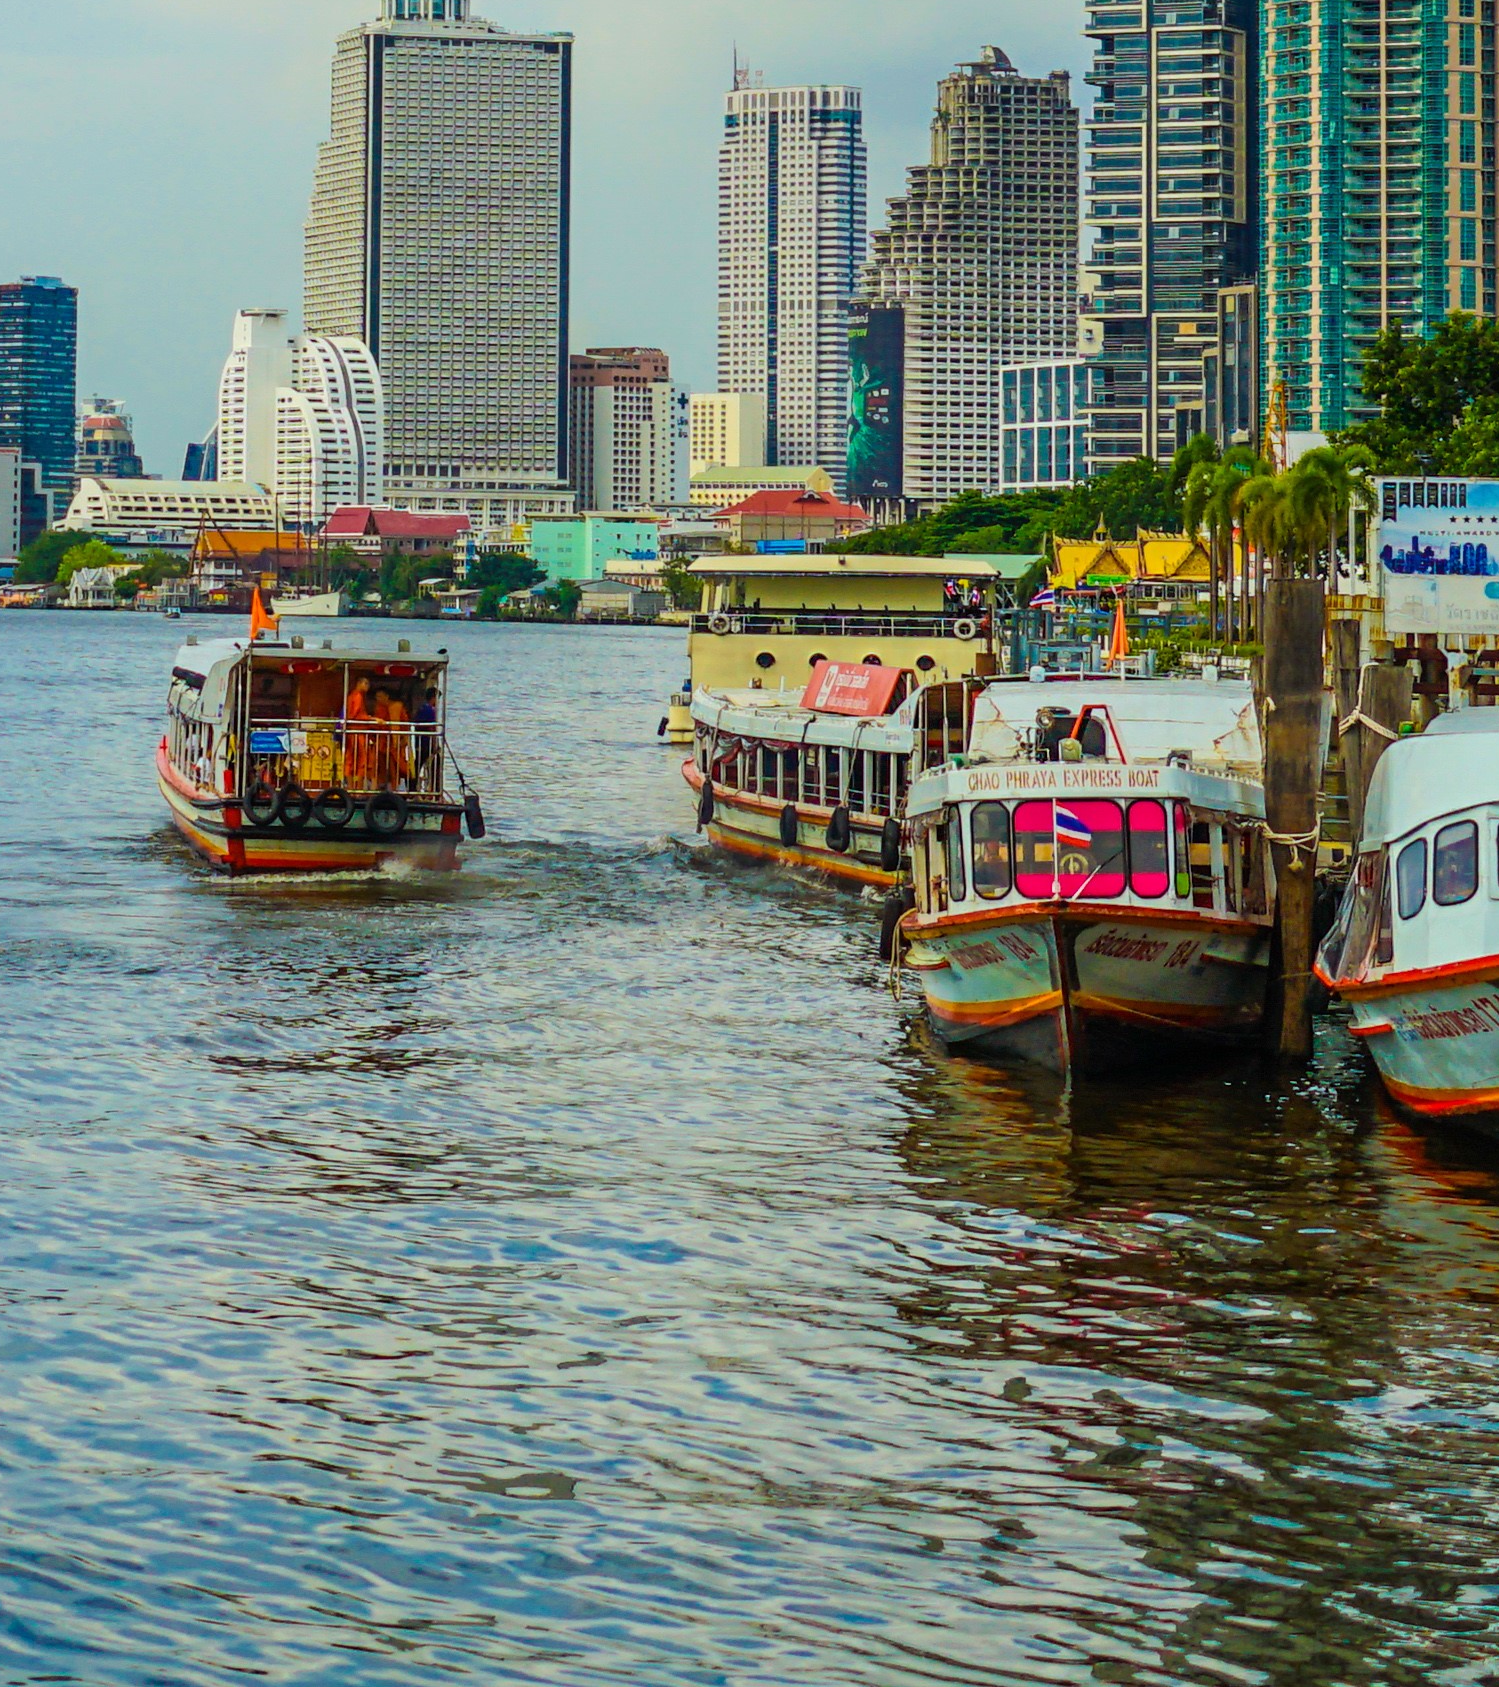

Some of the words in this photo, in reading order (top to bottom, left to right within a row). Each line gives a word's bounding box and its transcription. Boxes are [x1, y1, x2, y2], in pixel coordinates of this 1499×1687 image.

[968, 771, 999, 791] CHAO
[1006, 769, 1057, 789] PHRAYA
[1063, 769, 1122, 788] EXPRESS
[1128, 769, 1160, 787] BOAT
